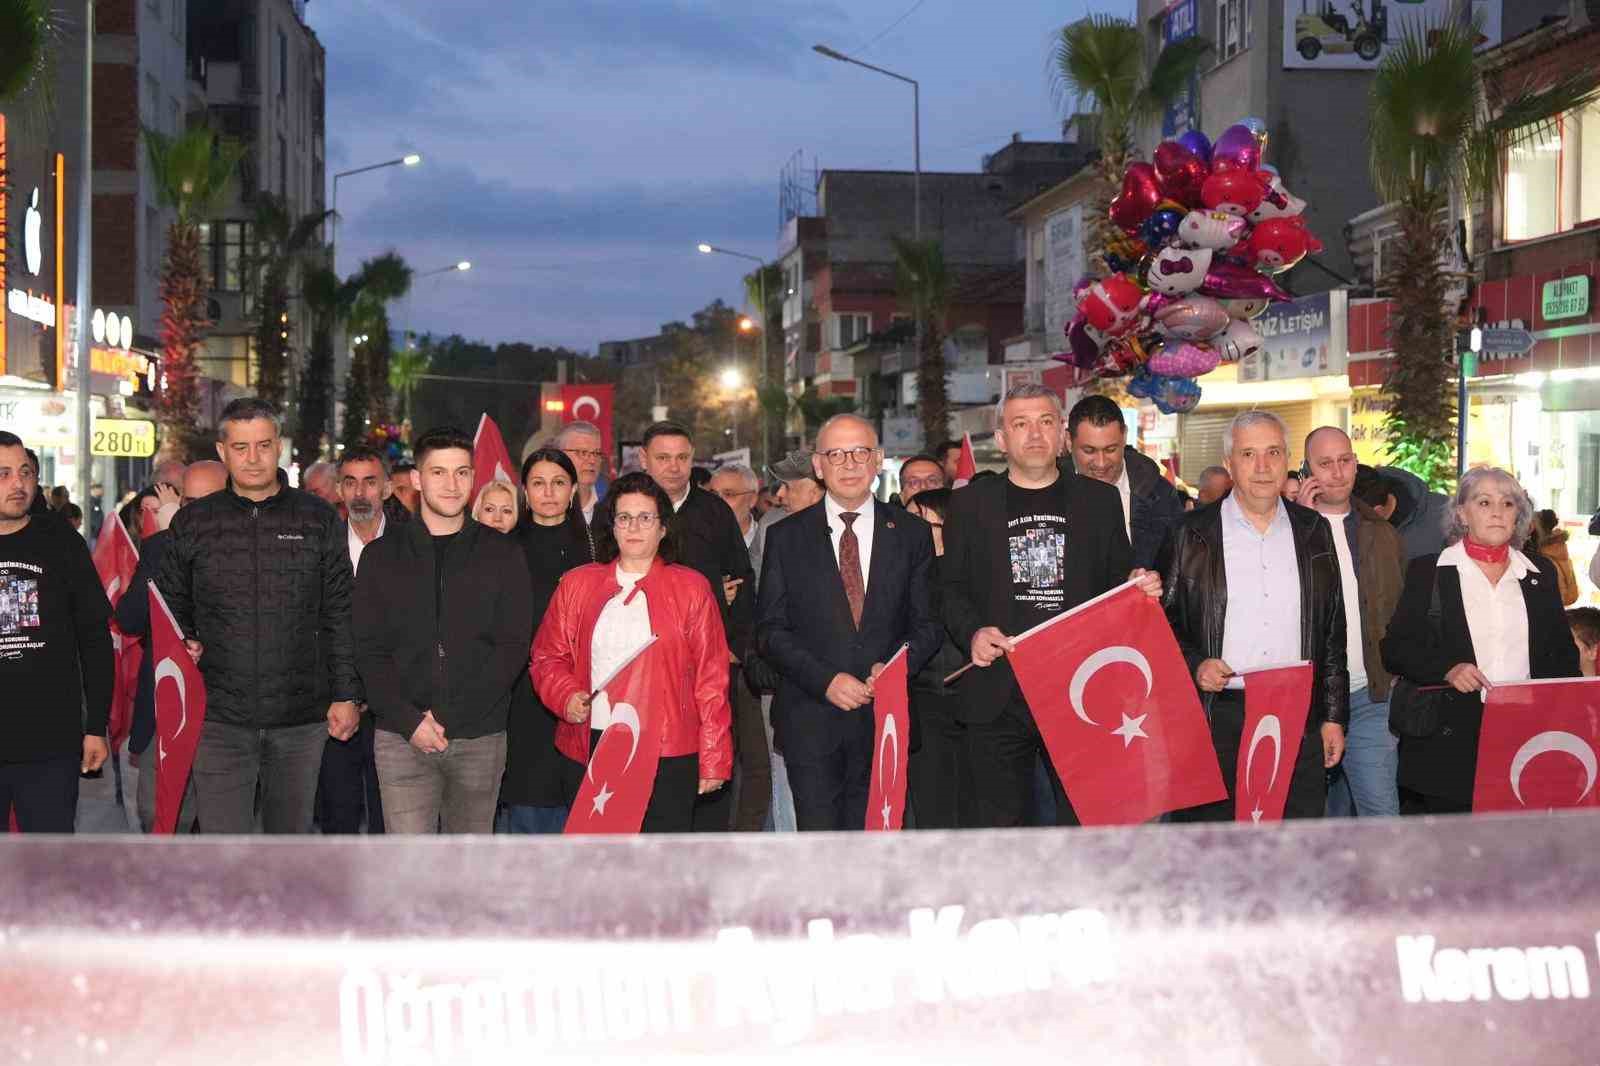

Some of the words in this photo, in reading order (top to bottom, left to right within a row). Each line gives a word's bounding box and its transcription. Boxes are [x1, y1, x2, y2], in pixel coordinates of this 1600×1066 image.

[1256, 312, 1278, 337] ENİZ
[94, 431, 132, 453] 280
[1396, 934, 1590, 1003] Kerem
